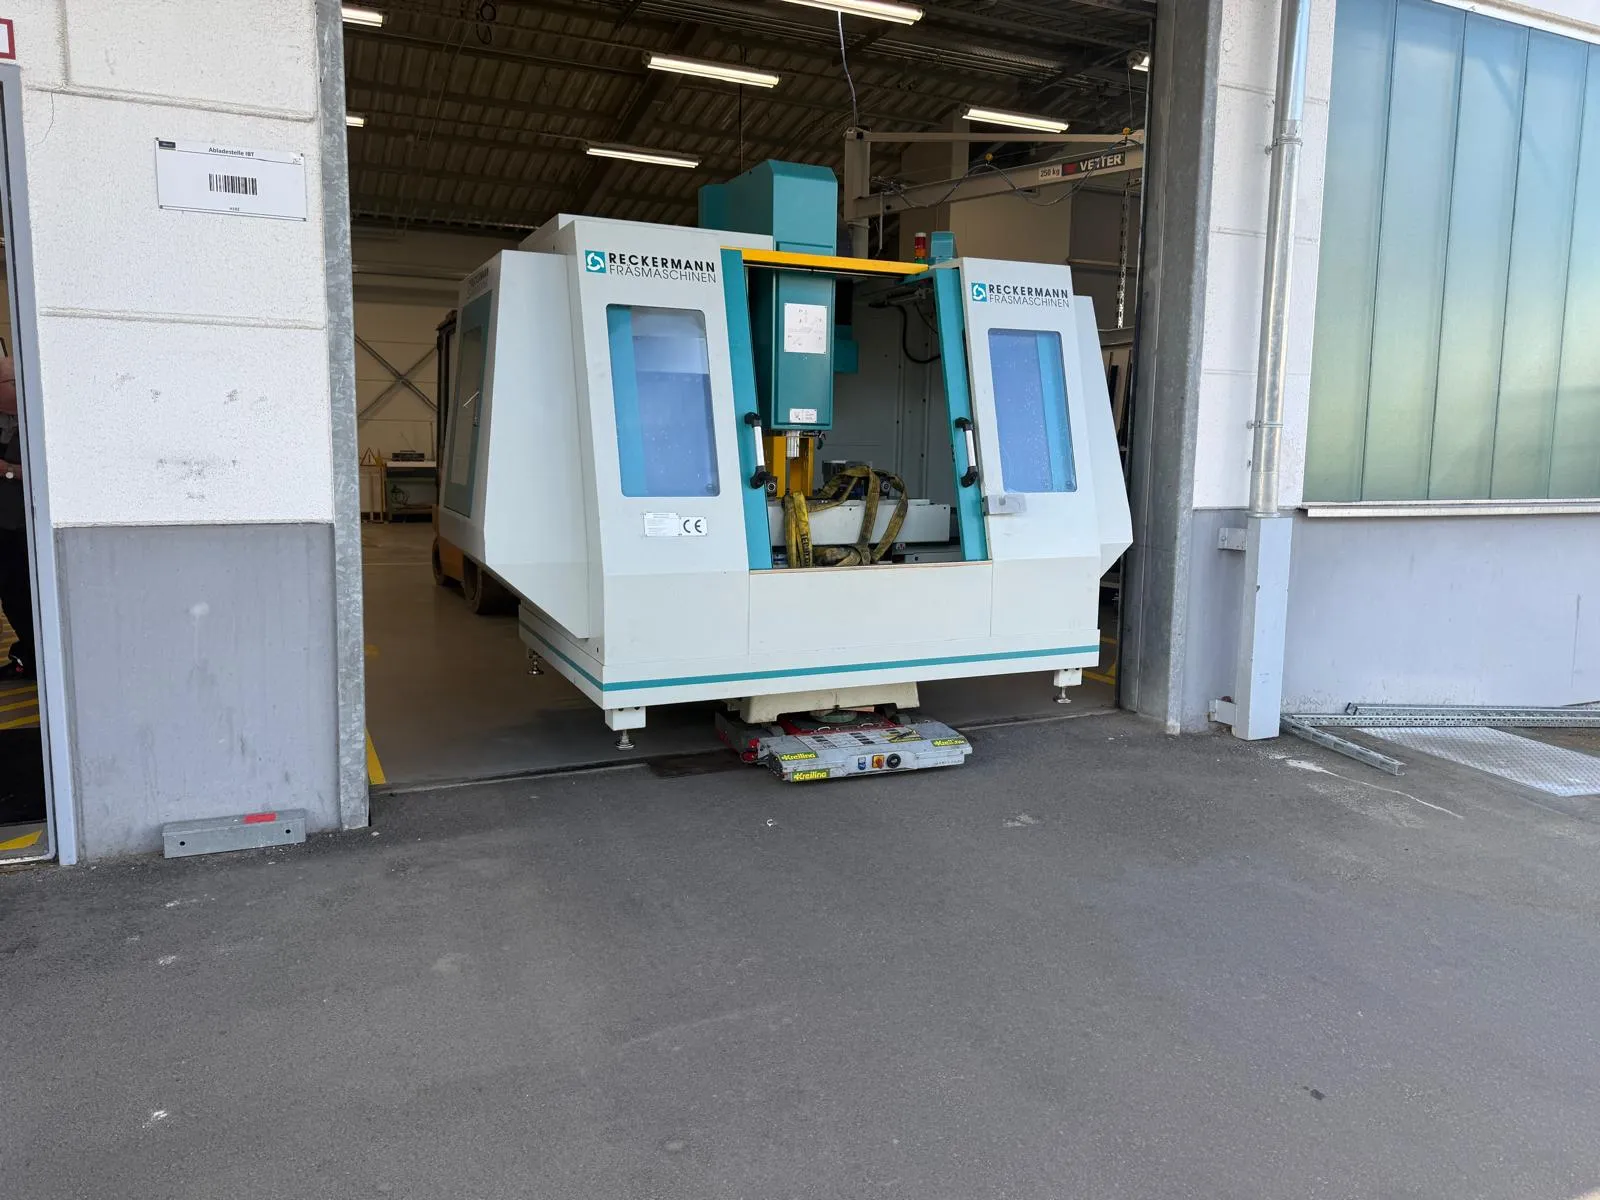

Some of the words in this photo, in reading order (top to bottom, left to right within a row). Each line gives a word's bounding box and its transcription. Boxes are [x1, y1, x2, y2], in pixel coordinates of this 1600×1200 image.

[209, 147, 244, 156] Abladestelle
[1080, 154, 1122, 171] VETTER
[609, 252, 715, 272] RECKERMANN
[609, 264, 717, 283] FRÄSMASCHINEN
[988, 284, 1068, 299] RECKERMANN
